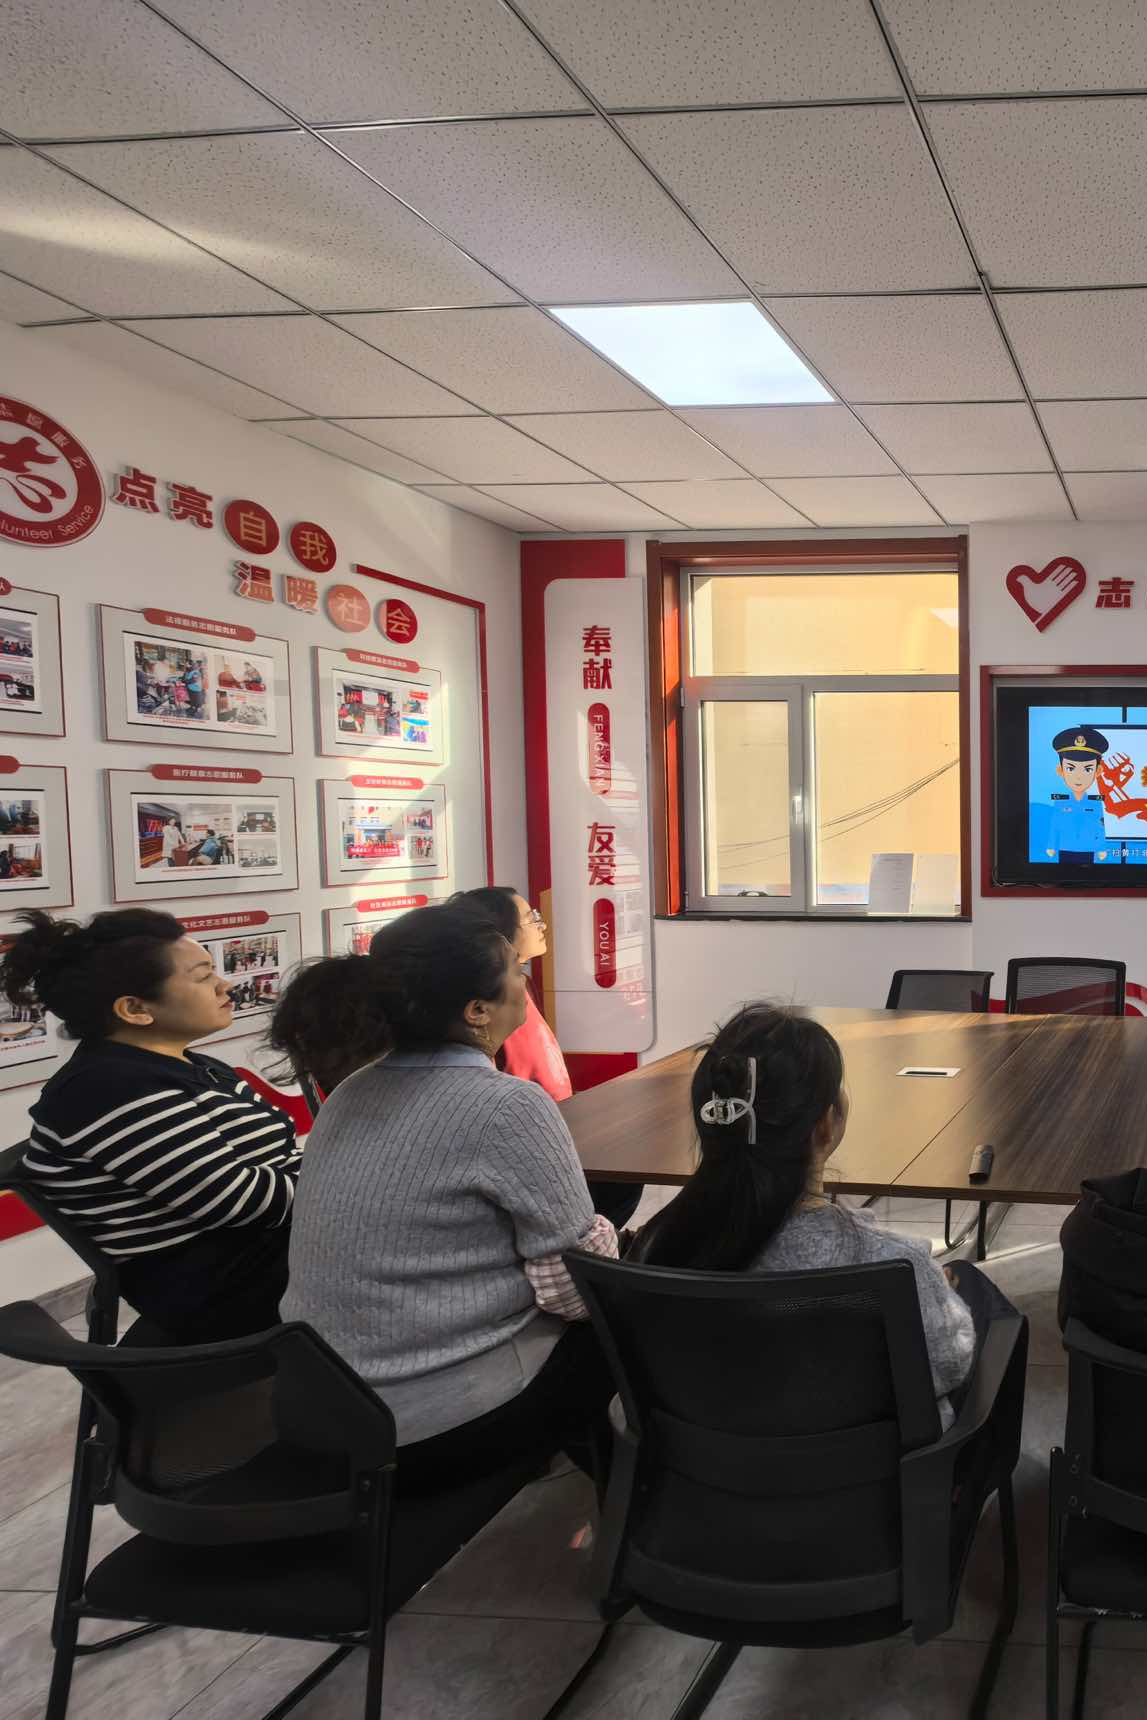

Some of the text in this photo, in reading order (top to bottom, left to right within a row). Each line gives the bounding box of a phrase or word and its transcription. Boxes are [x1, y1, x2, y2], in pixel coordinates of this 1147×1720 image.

[57, 504, 94, 536] Service
[112, 468, 330, 566] 点亮自我
[235, 560, 410, 637] 温暖社会
[582, 626, 613, 690] 奉献
[587, 822, 616, 886] 友爱
[600, 921, 610, 966] YOU AI
